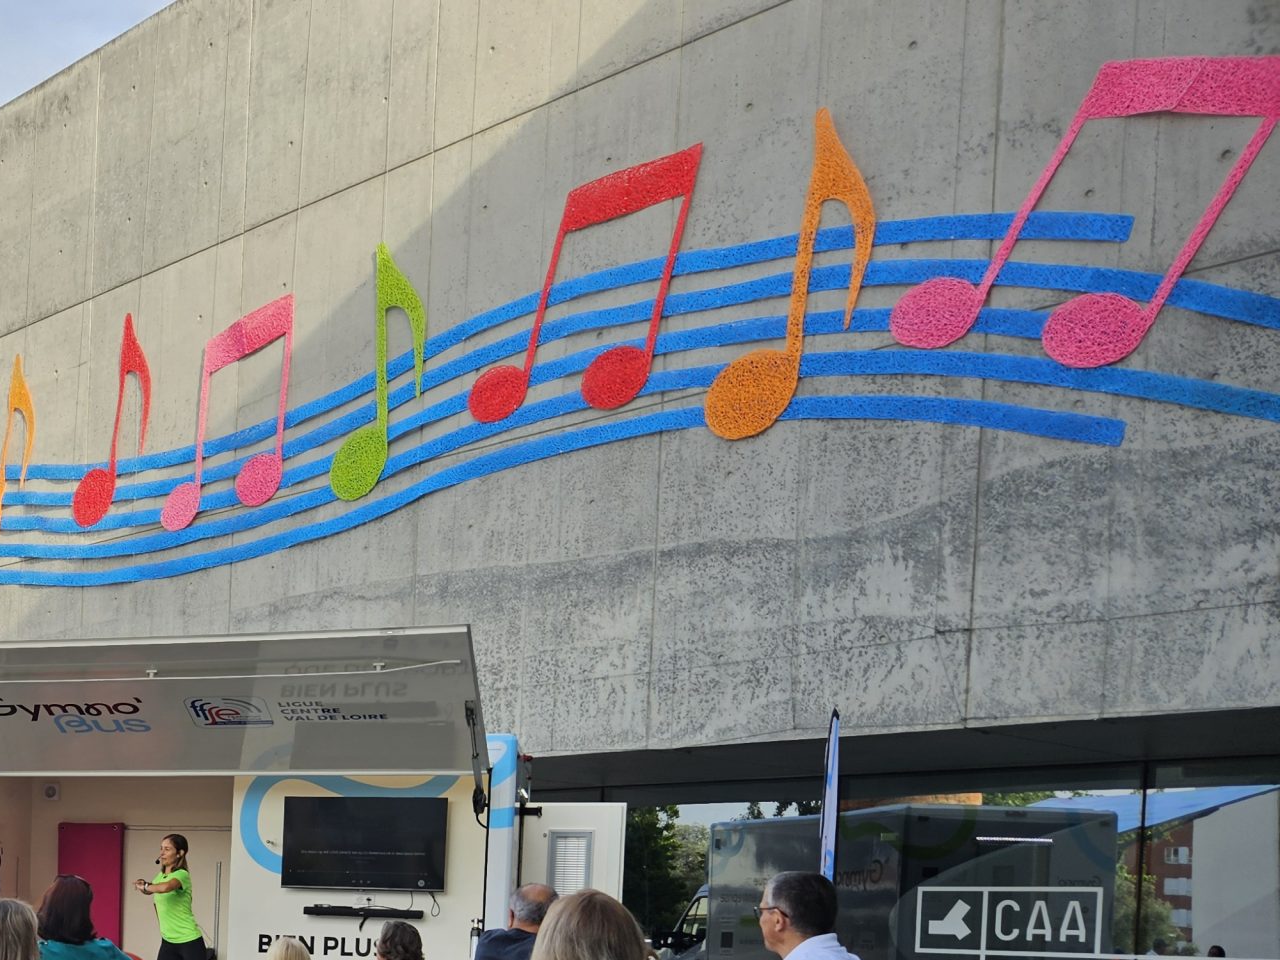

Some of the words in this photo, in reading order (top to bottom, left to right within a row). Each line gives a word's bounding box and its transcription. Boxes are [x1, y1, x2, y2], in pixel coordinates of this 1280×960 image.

[995, 899, 1087, 943] CAA
[258, 934, 315, 955] BN
[323, 936, 377, 957] PLU
